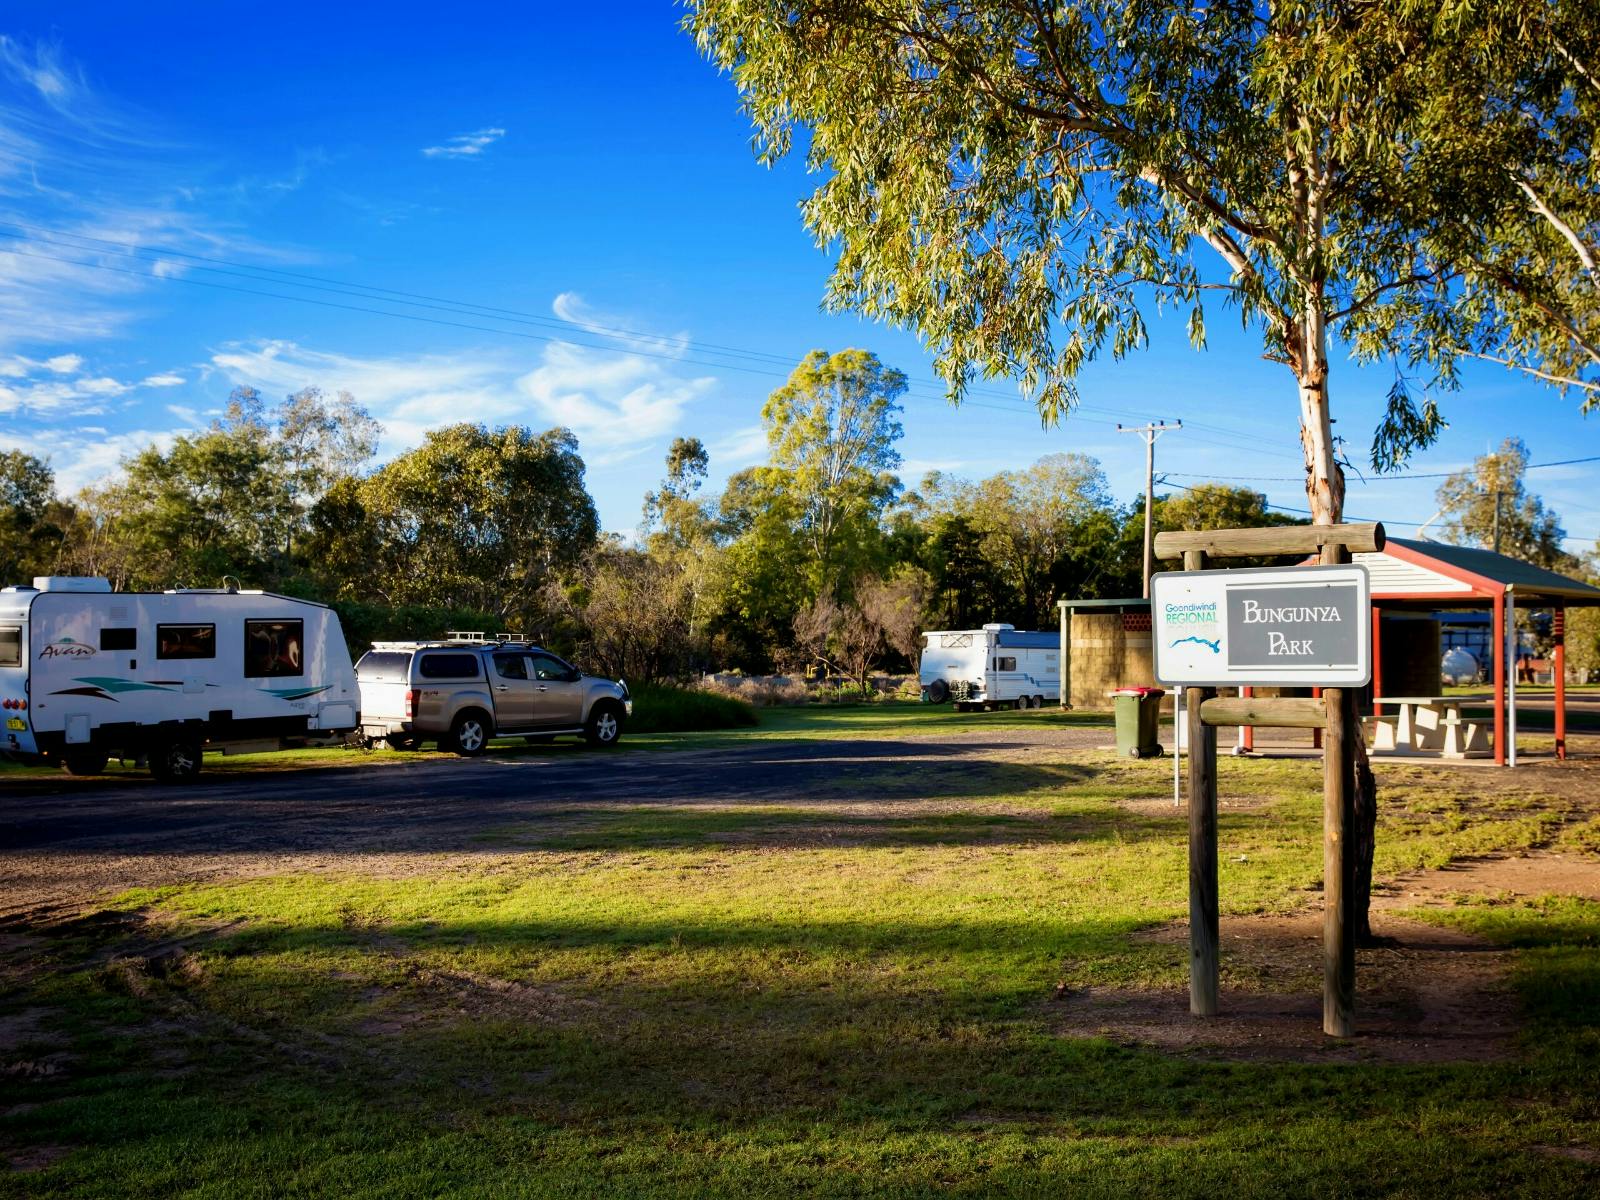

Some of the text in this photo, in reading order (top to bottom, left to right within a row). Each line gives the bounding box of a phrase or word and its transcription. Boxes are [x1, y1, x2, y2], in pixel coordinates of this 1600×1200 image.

[1166, 612, 1218, 625] REGIONAL
[1242, 599, 1341, 623] BUNGUNYA
[1267, 631, 1314, 655] PARK
